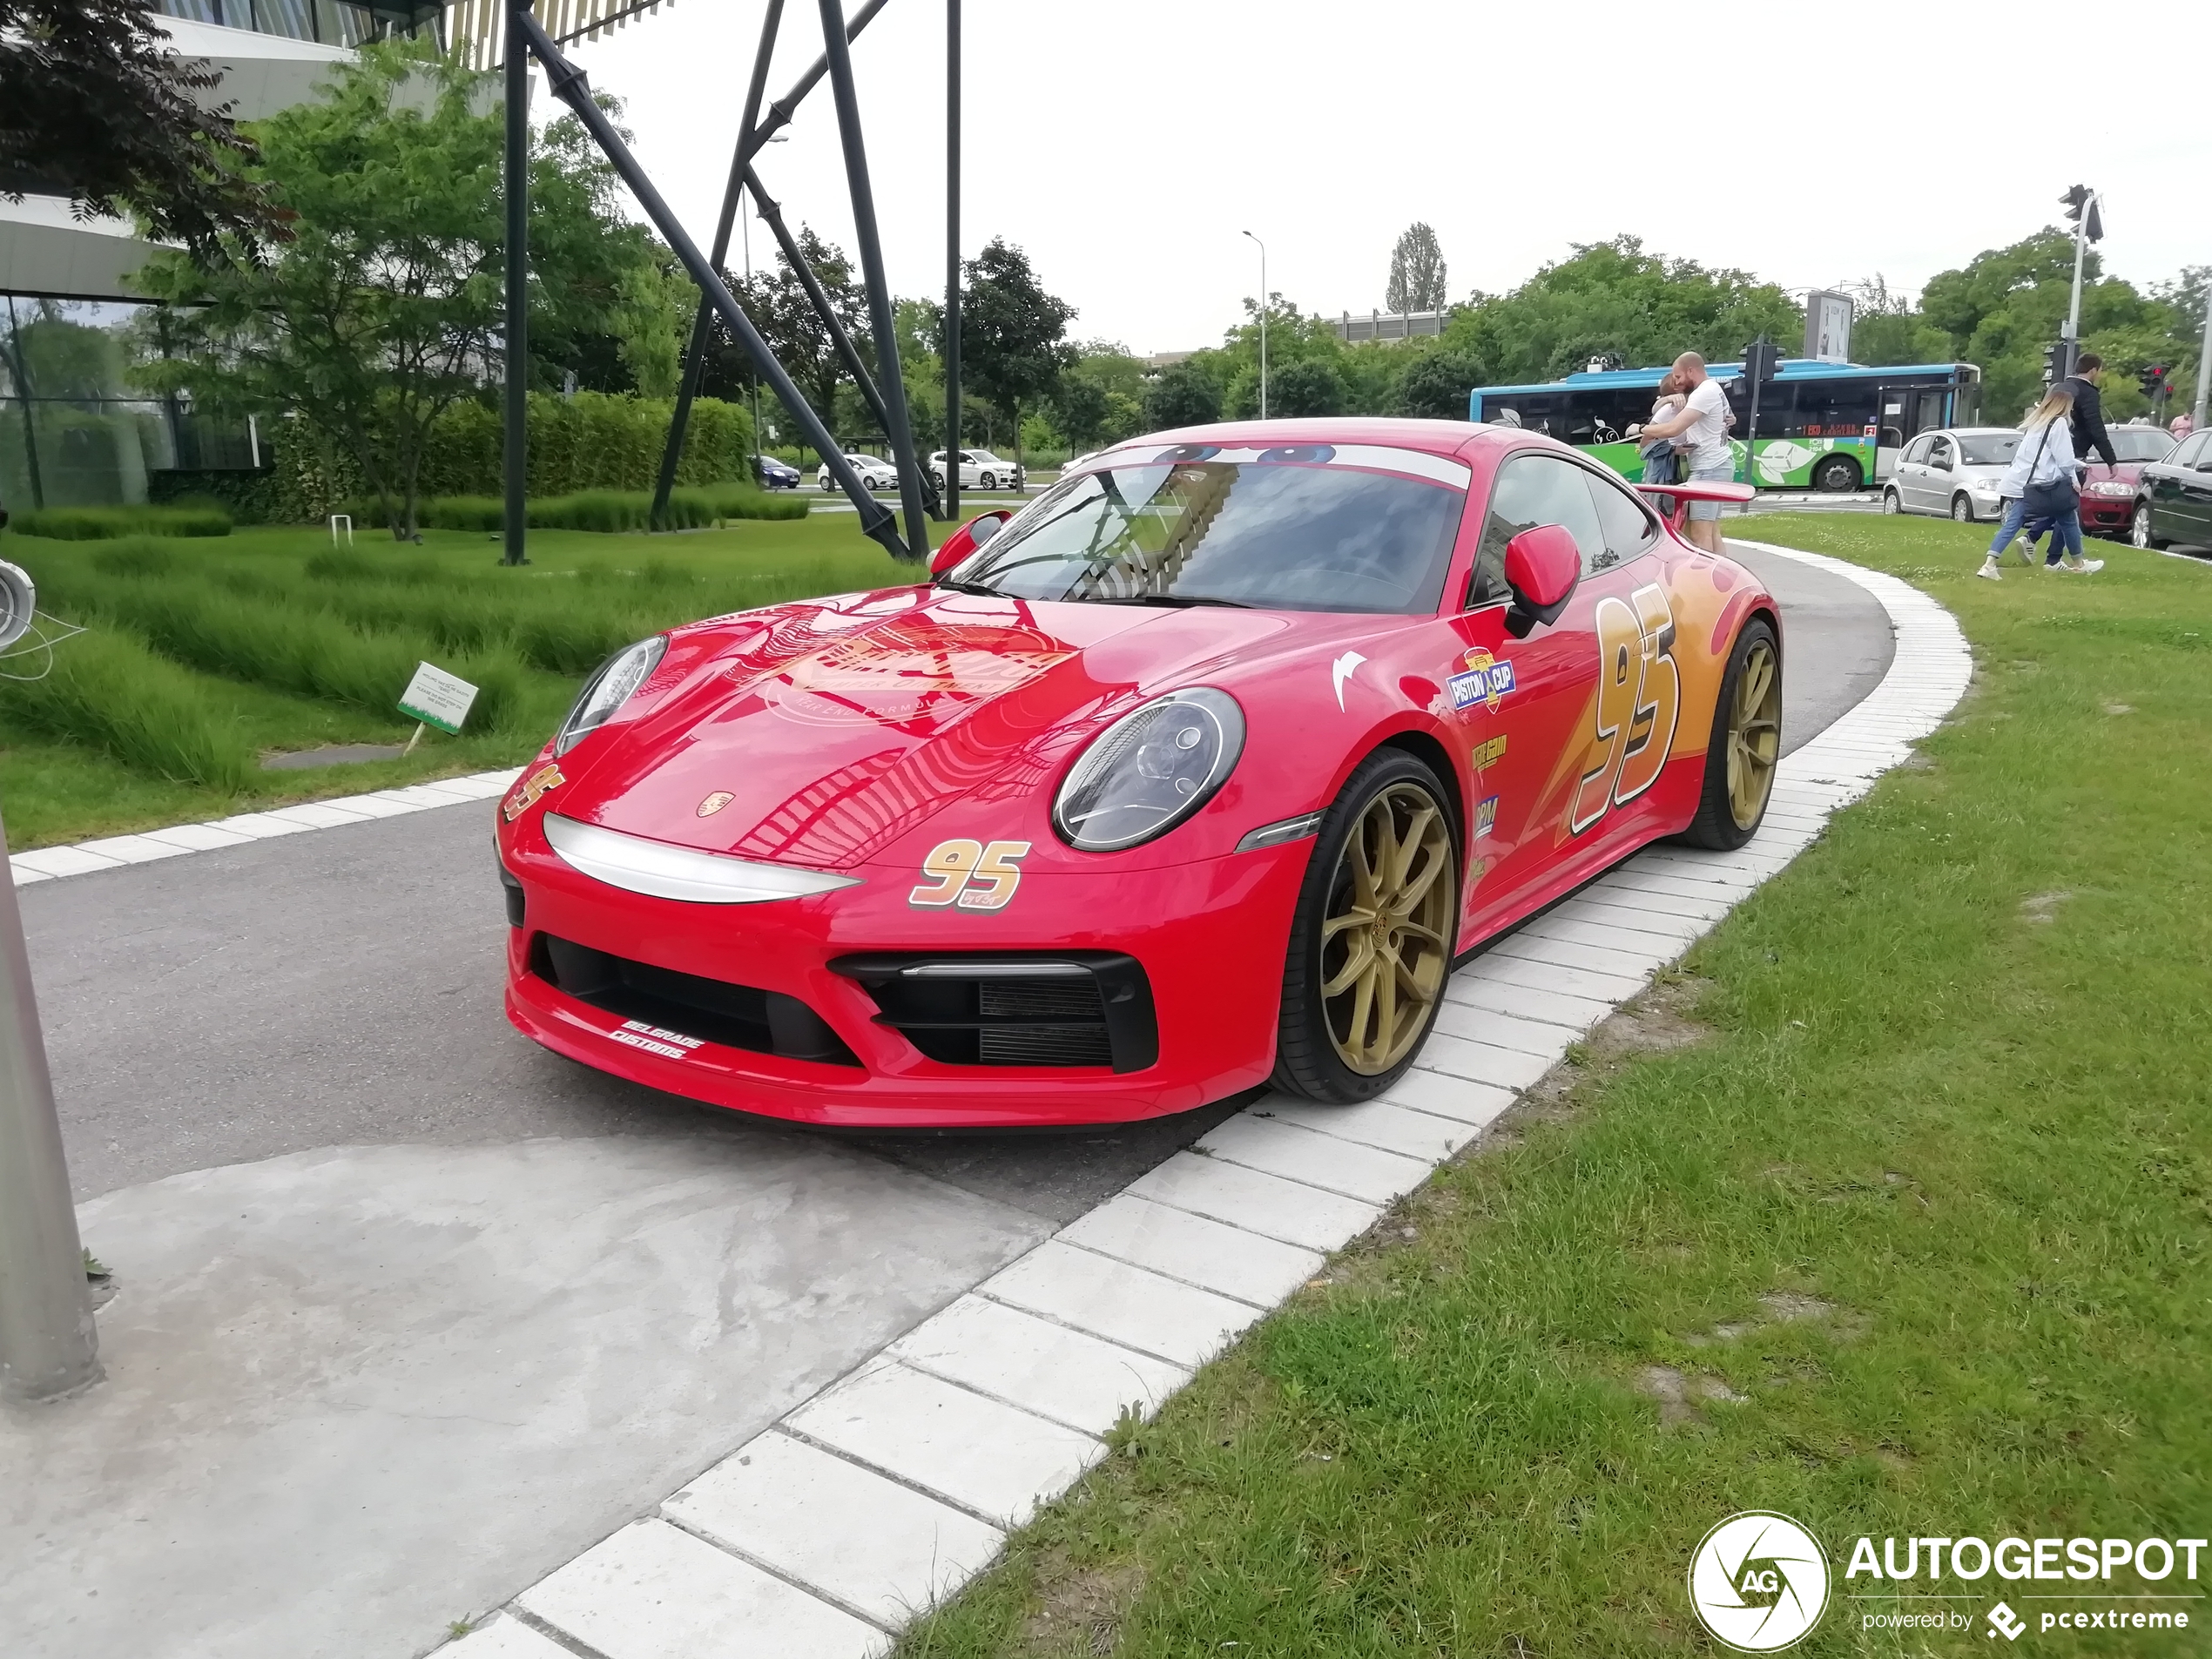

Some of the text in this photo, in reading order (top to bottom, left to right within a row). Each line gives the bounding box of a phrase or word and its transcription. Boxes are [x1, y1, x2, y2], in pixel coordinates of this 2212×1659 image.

[415, 685, 431, 696] PLEASE
[1450, 665, 1512, 705] PISTON CUP
[794, 696, 948, 717] REAR END FORMULA
[1570, 582, 1681, 838] 95
[502, 763, 567, 823] 95
[908, 838, 1033, 913] 95
[608, 1030, 687, 1061] CUSTOMS
[621, 1020, 705, 1049] BELGRADE
